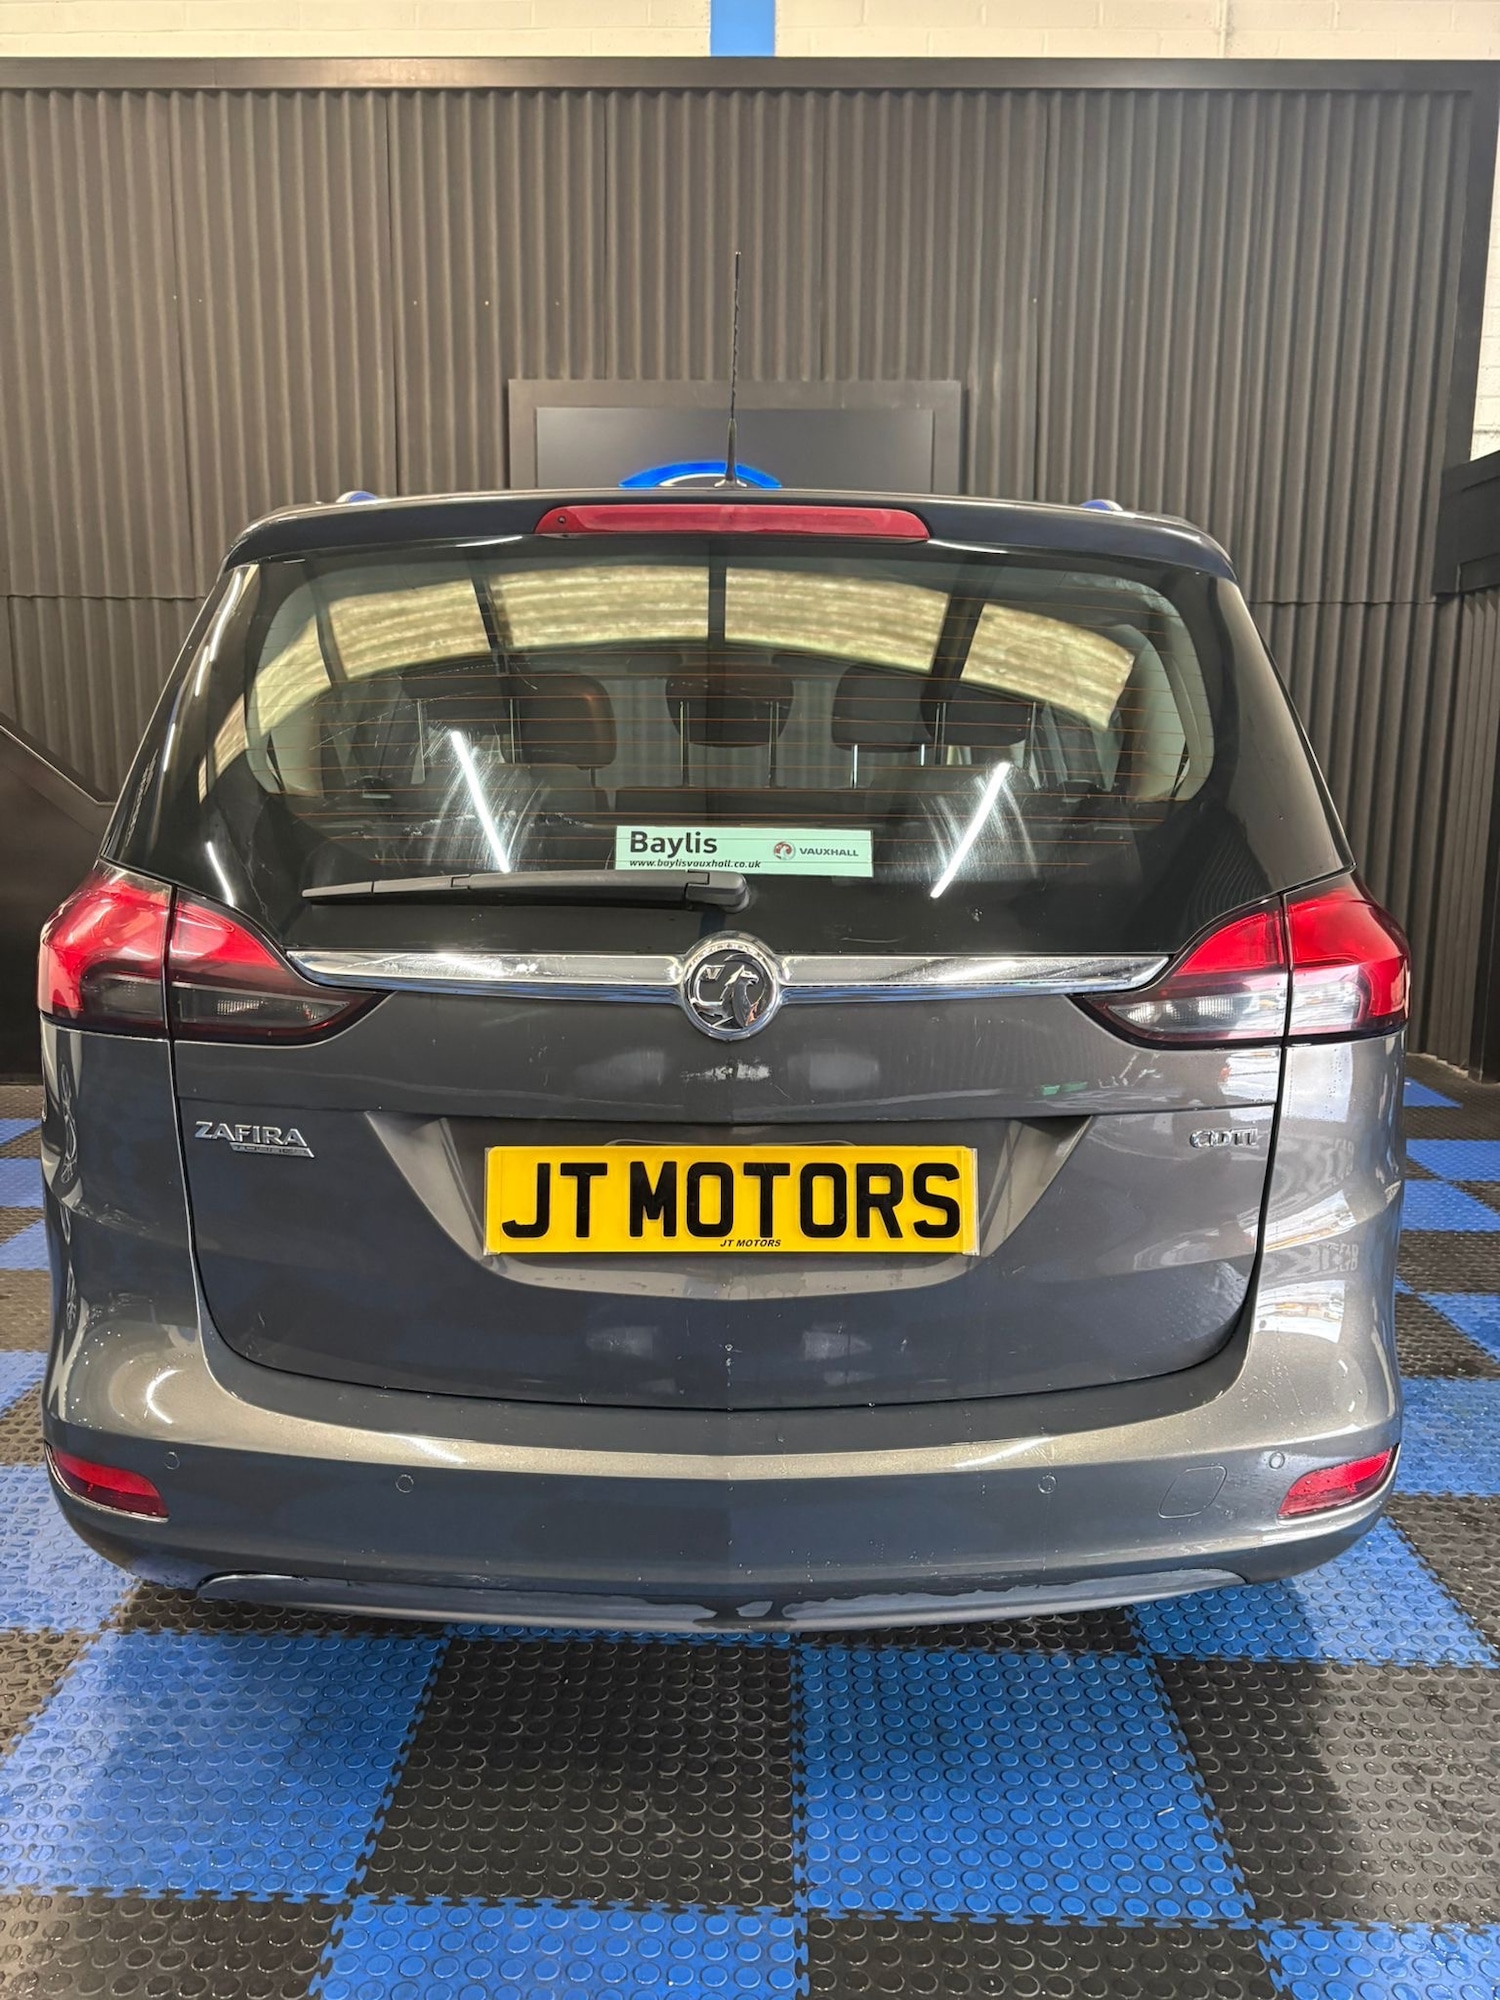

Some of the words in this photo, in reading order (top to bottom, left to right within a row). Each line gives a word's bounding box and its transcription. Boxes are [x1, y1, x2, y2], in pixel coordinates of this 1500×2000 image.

[630, 831, 718, 859] Baylis
[799, 848, 859, 857] VAUXHALL
[629, 858, 761, 869] www.baylisvauxhall.co.uk
[194, 1120, 308, 1147] ZAFIRA
[1190, 1128, 1258, 1148] CDTI
[501, 1161, 607, 1239] JT
[629, 1160, 961, 1239] MOTORS
[720, 1239, 734, 1248] JT
[736, 1239, 781, 1248] MOTORS
